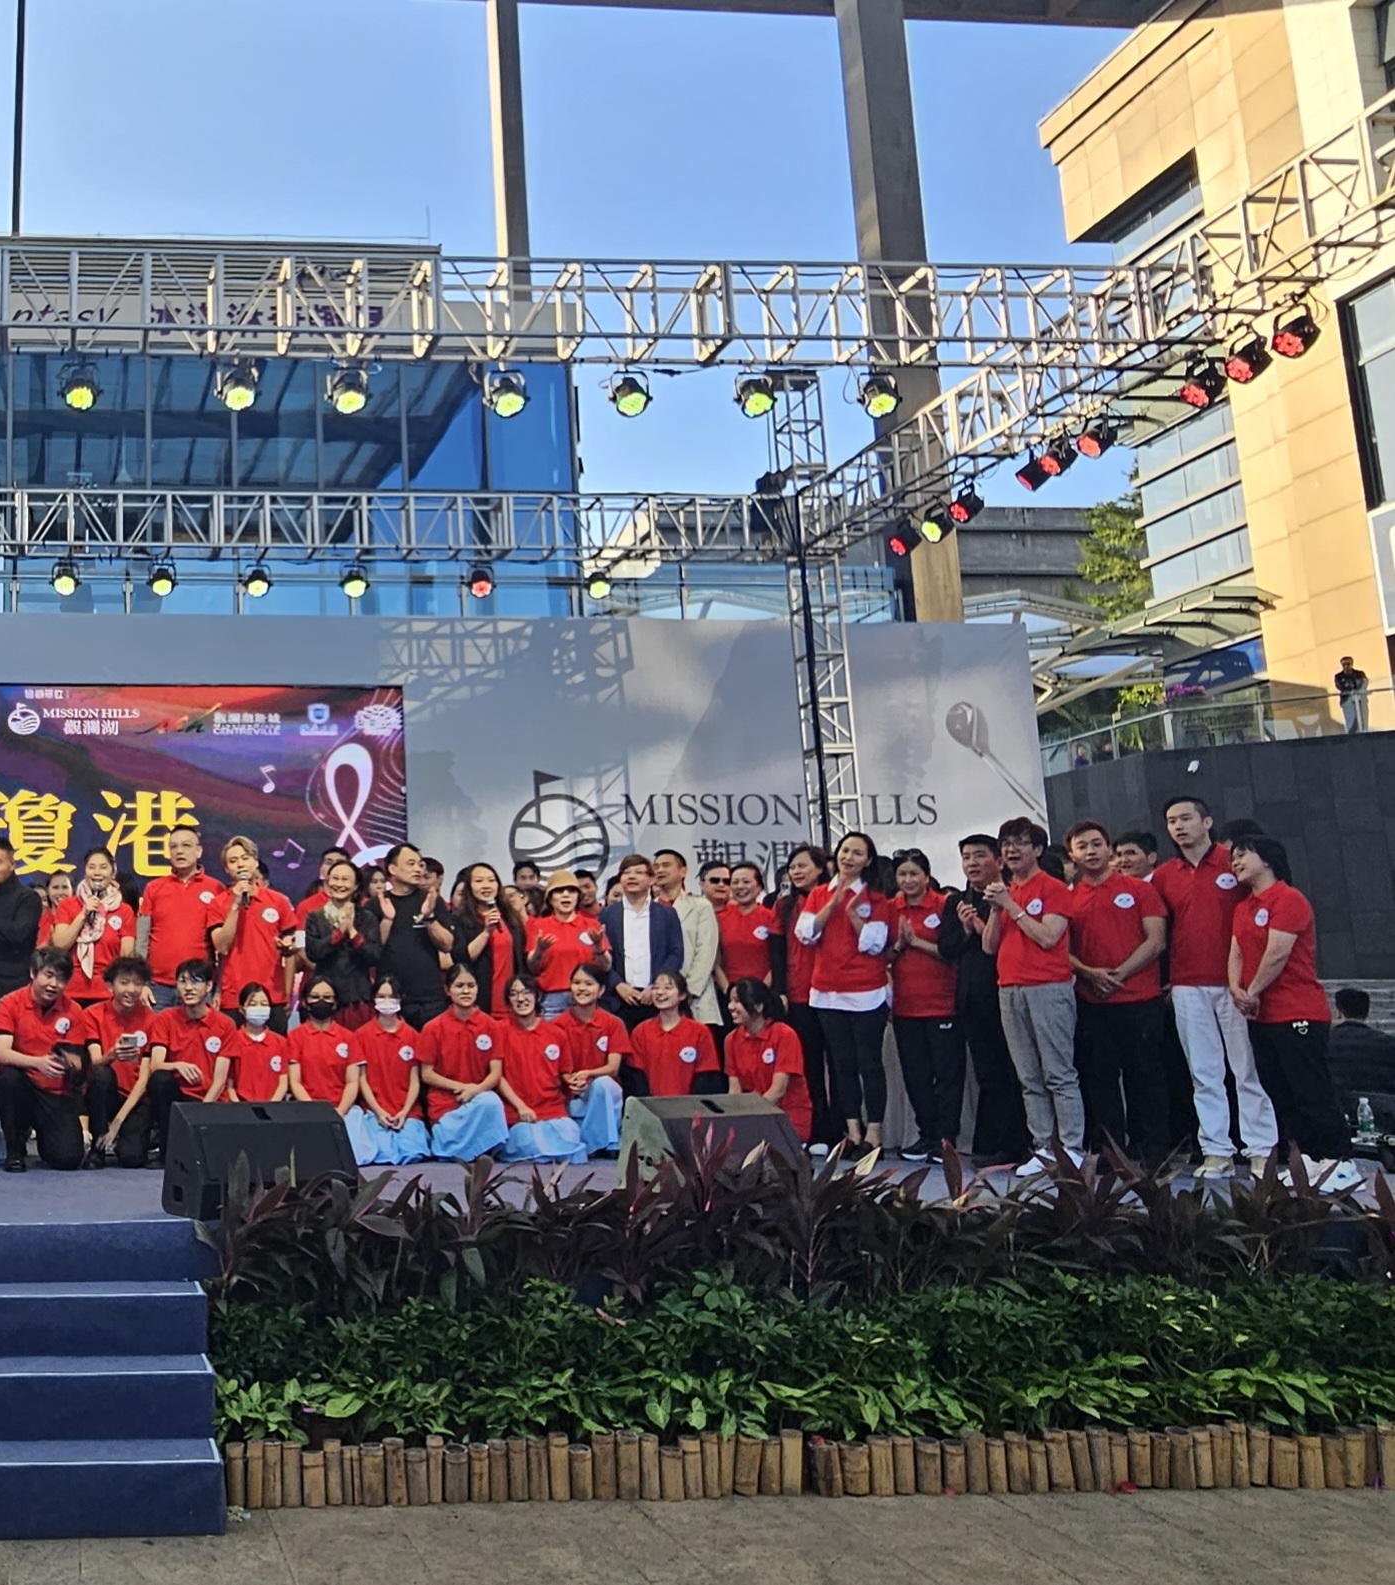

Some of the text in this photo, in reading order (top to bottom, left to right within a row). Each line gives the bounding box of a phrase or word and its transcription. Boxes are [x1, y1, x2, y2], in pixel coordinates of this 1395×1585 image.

[42, 707, 140, 718] MISSION HILLS
[620, 793, 938, 827] MISSION LLS
